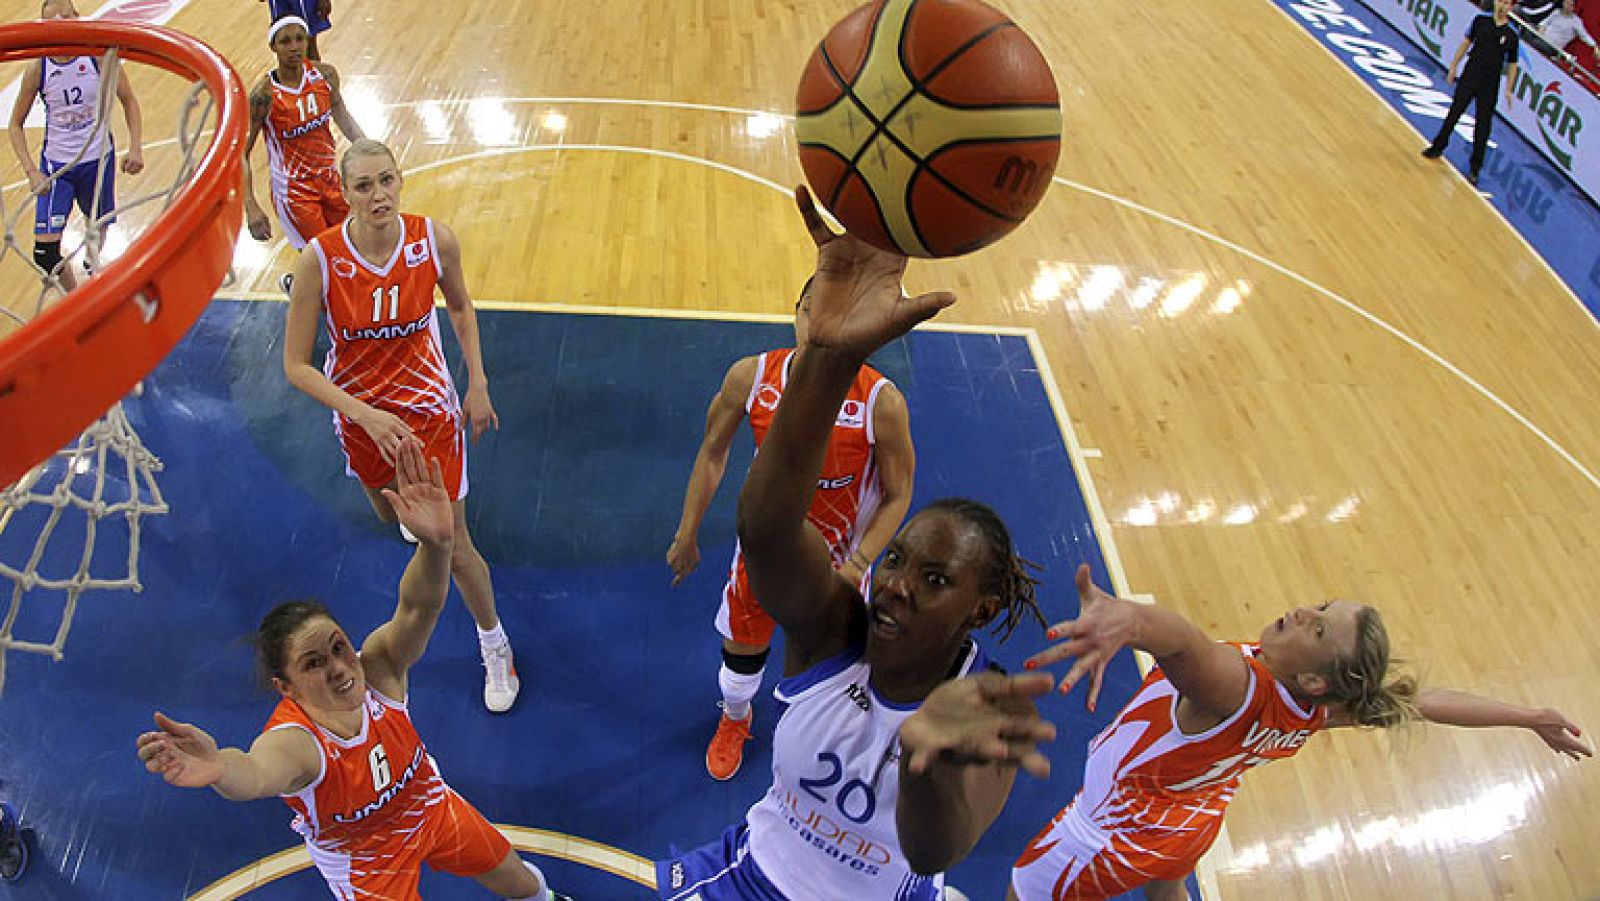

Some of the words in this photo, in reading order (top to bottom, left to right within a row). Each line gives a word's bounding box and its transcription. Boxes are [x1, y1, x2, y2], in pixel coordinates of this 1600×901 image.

[63, 85, 83, 106] 12
[296, 93, 319, 122] 14
[372, 285, 399, 322] 11
[368, 743, 392, 792] 6
[799, 752, 876, 824] 20
